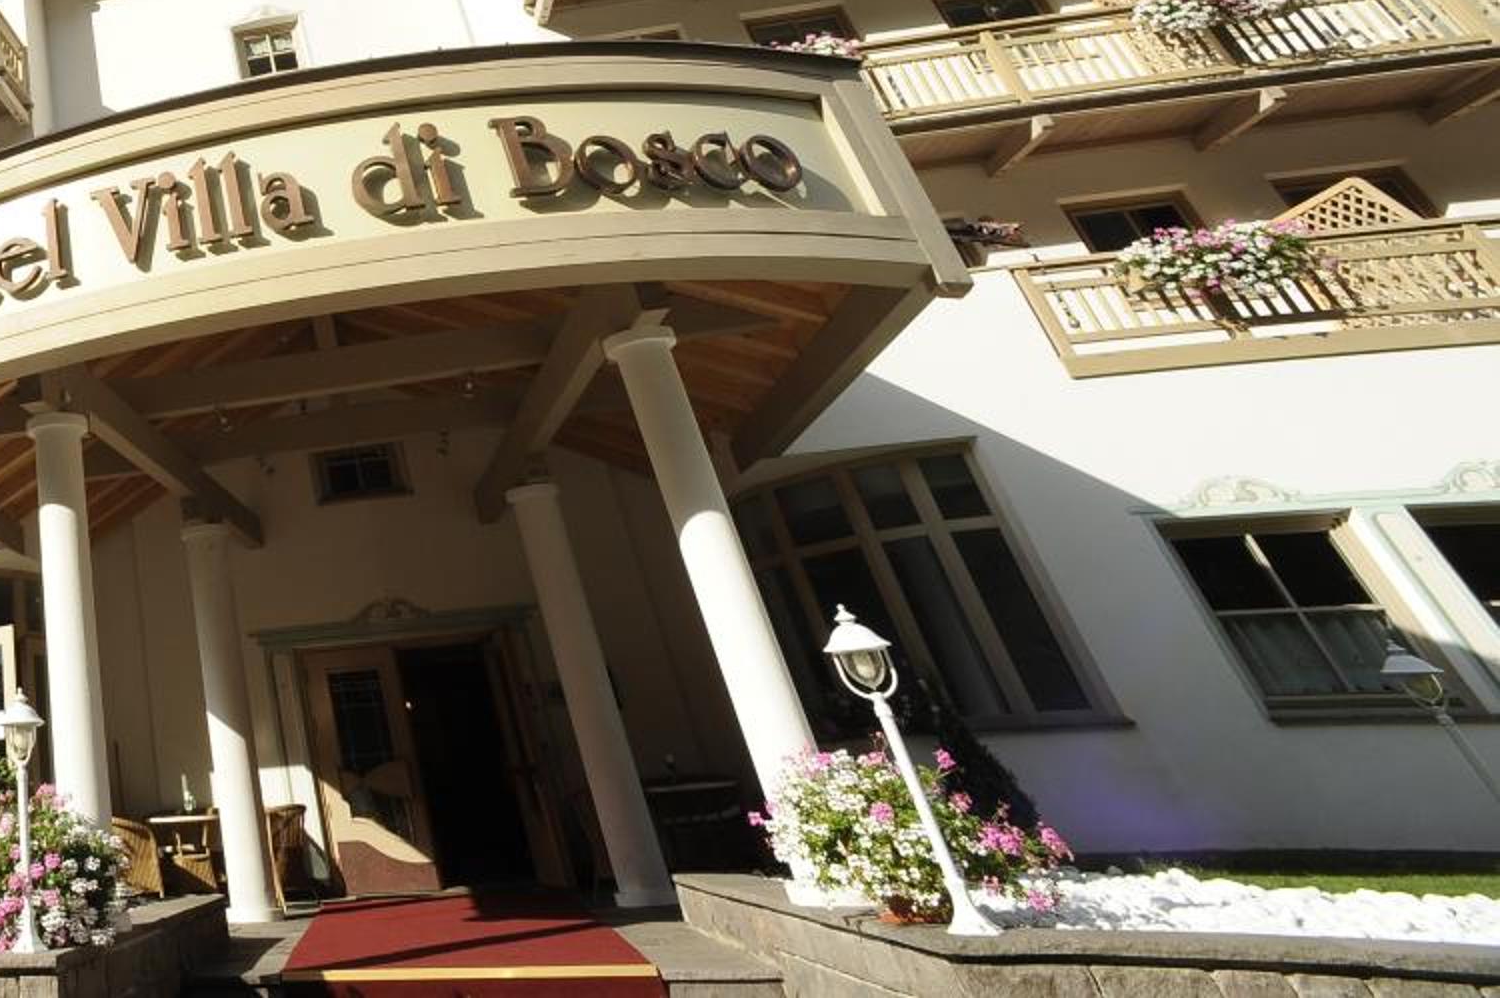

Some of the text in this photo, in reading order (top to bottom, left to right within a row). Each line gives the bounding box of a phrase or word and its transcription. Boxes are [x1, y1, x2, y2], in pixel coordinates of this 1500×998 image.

[91, 150, 314, 263] Villa
[351, 121, 462, 217] di
[487, 114, 802, 199] Bosco
